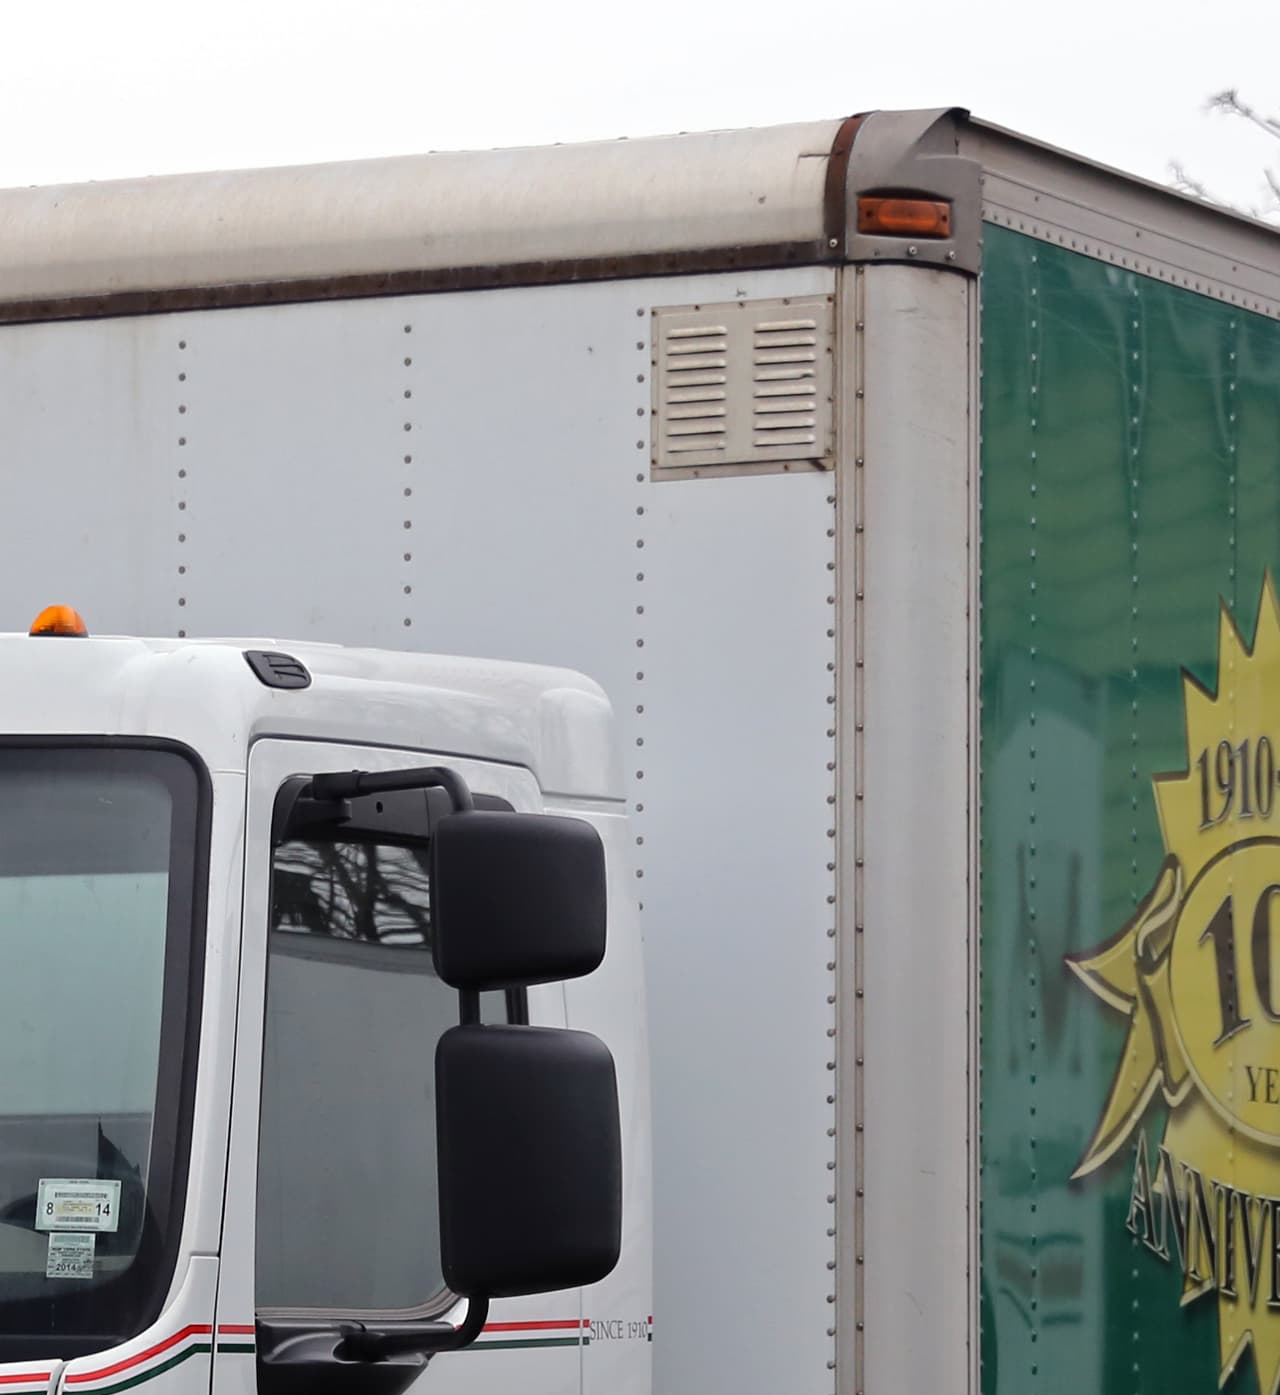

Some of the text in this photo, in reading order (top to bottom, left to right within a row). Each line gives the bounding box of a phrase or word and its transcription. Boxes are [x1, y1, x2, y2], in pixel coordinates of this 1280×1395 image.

[46, 1202, 54, 1215] 8
[95, 1202, 111, 1216] 14
[56, 1263, 76, 1272] 2014
[590, 1320, 648, 1341] SINCE 1910
